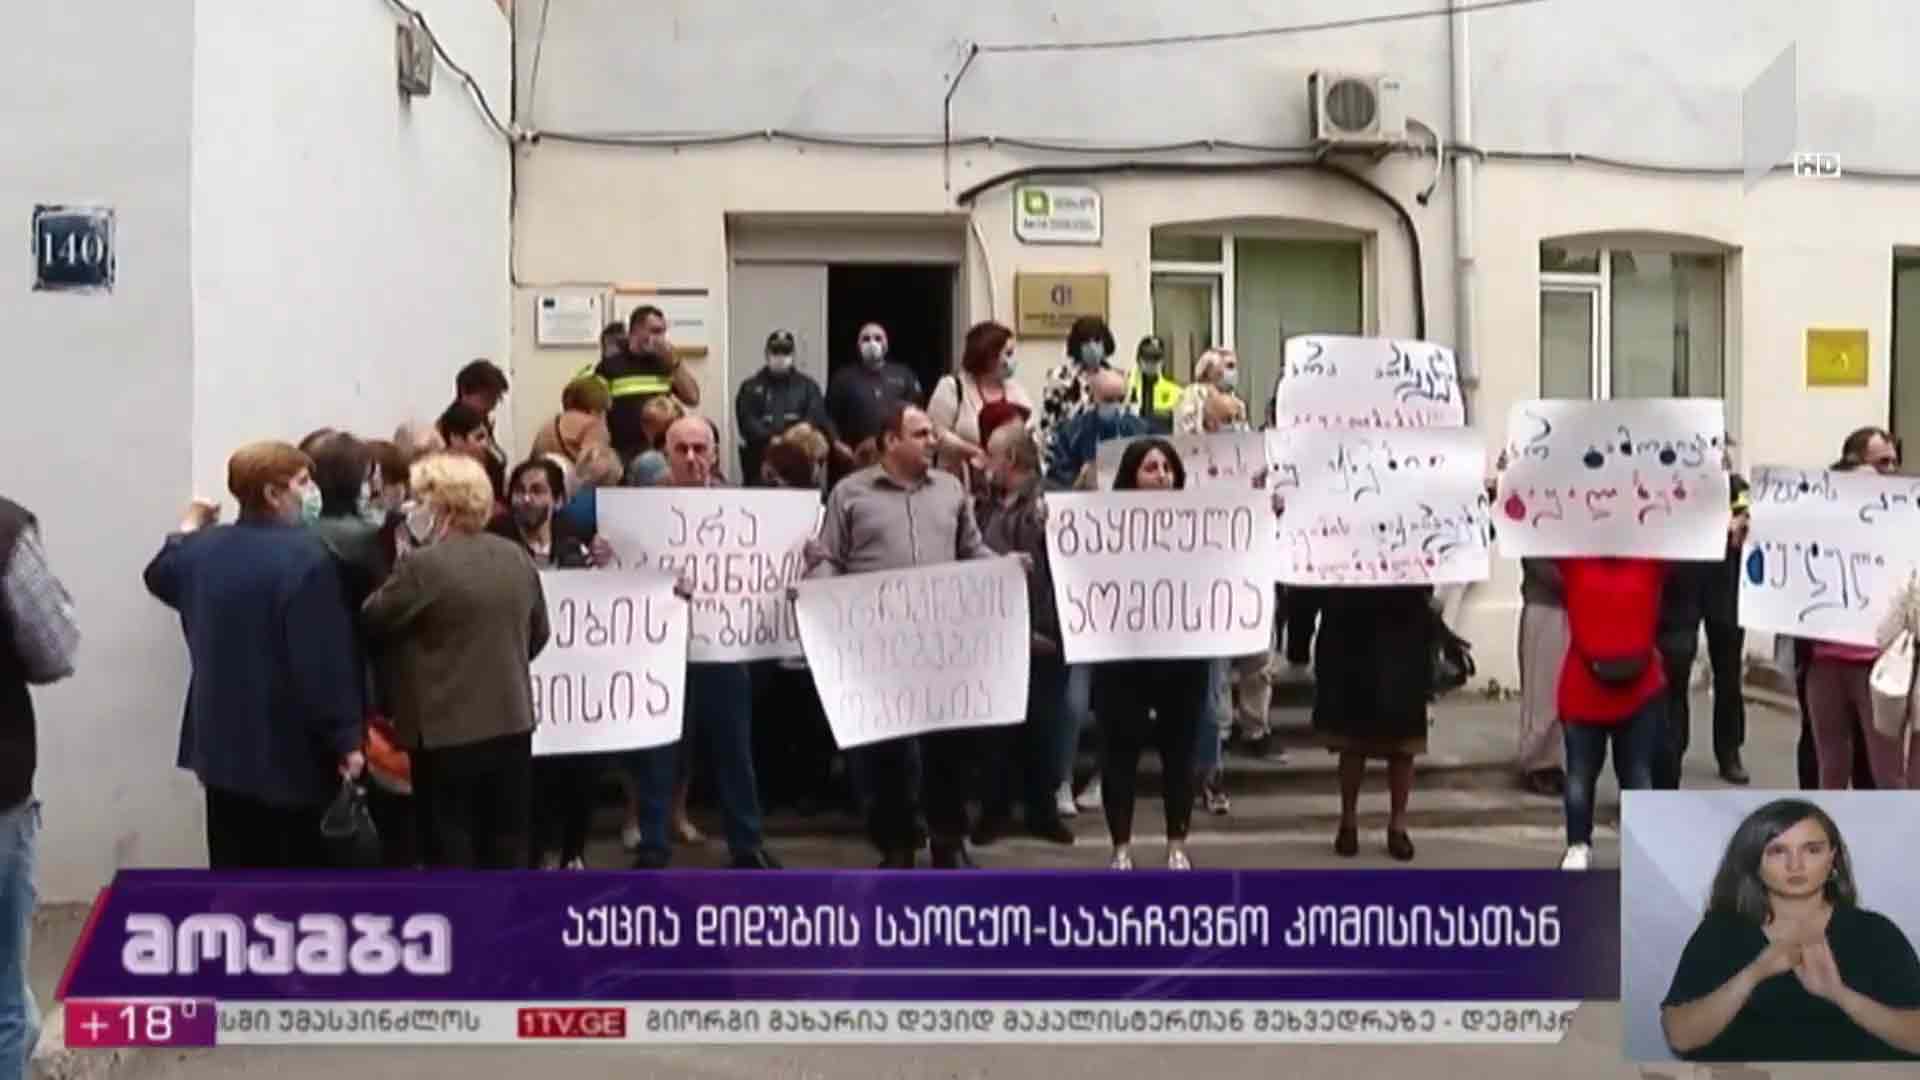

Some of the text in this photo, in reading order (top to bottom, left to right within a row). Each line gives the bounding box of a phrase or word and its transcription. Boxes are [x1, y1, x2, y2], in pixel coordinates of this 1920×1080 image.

[44, 231, 104, 265] 140
[668, 505, 759, 548] არა
[1055, 506, 1253, 557] გაყიდული
[555, 597, 668, 649] ების
